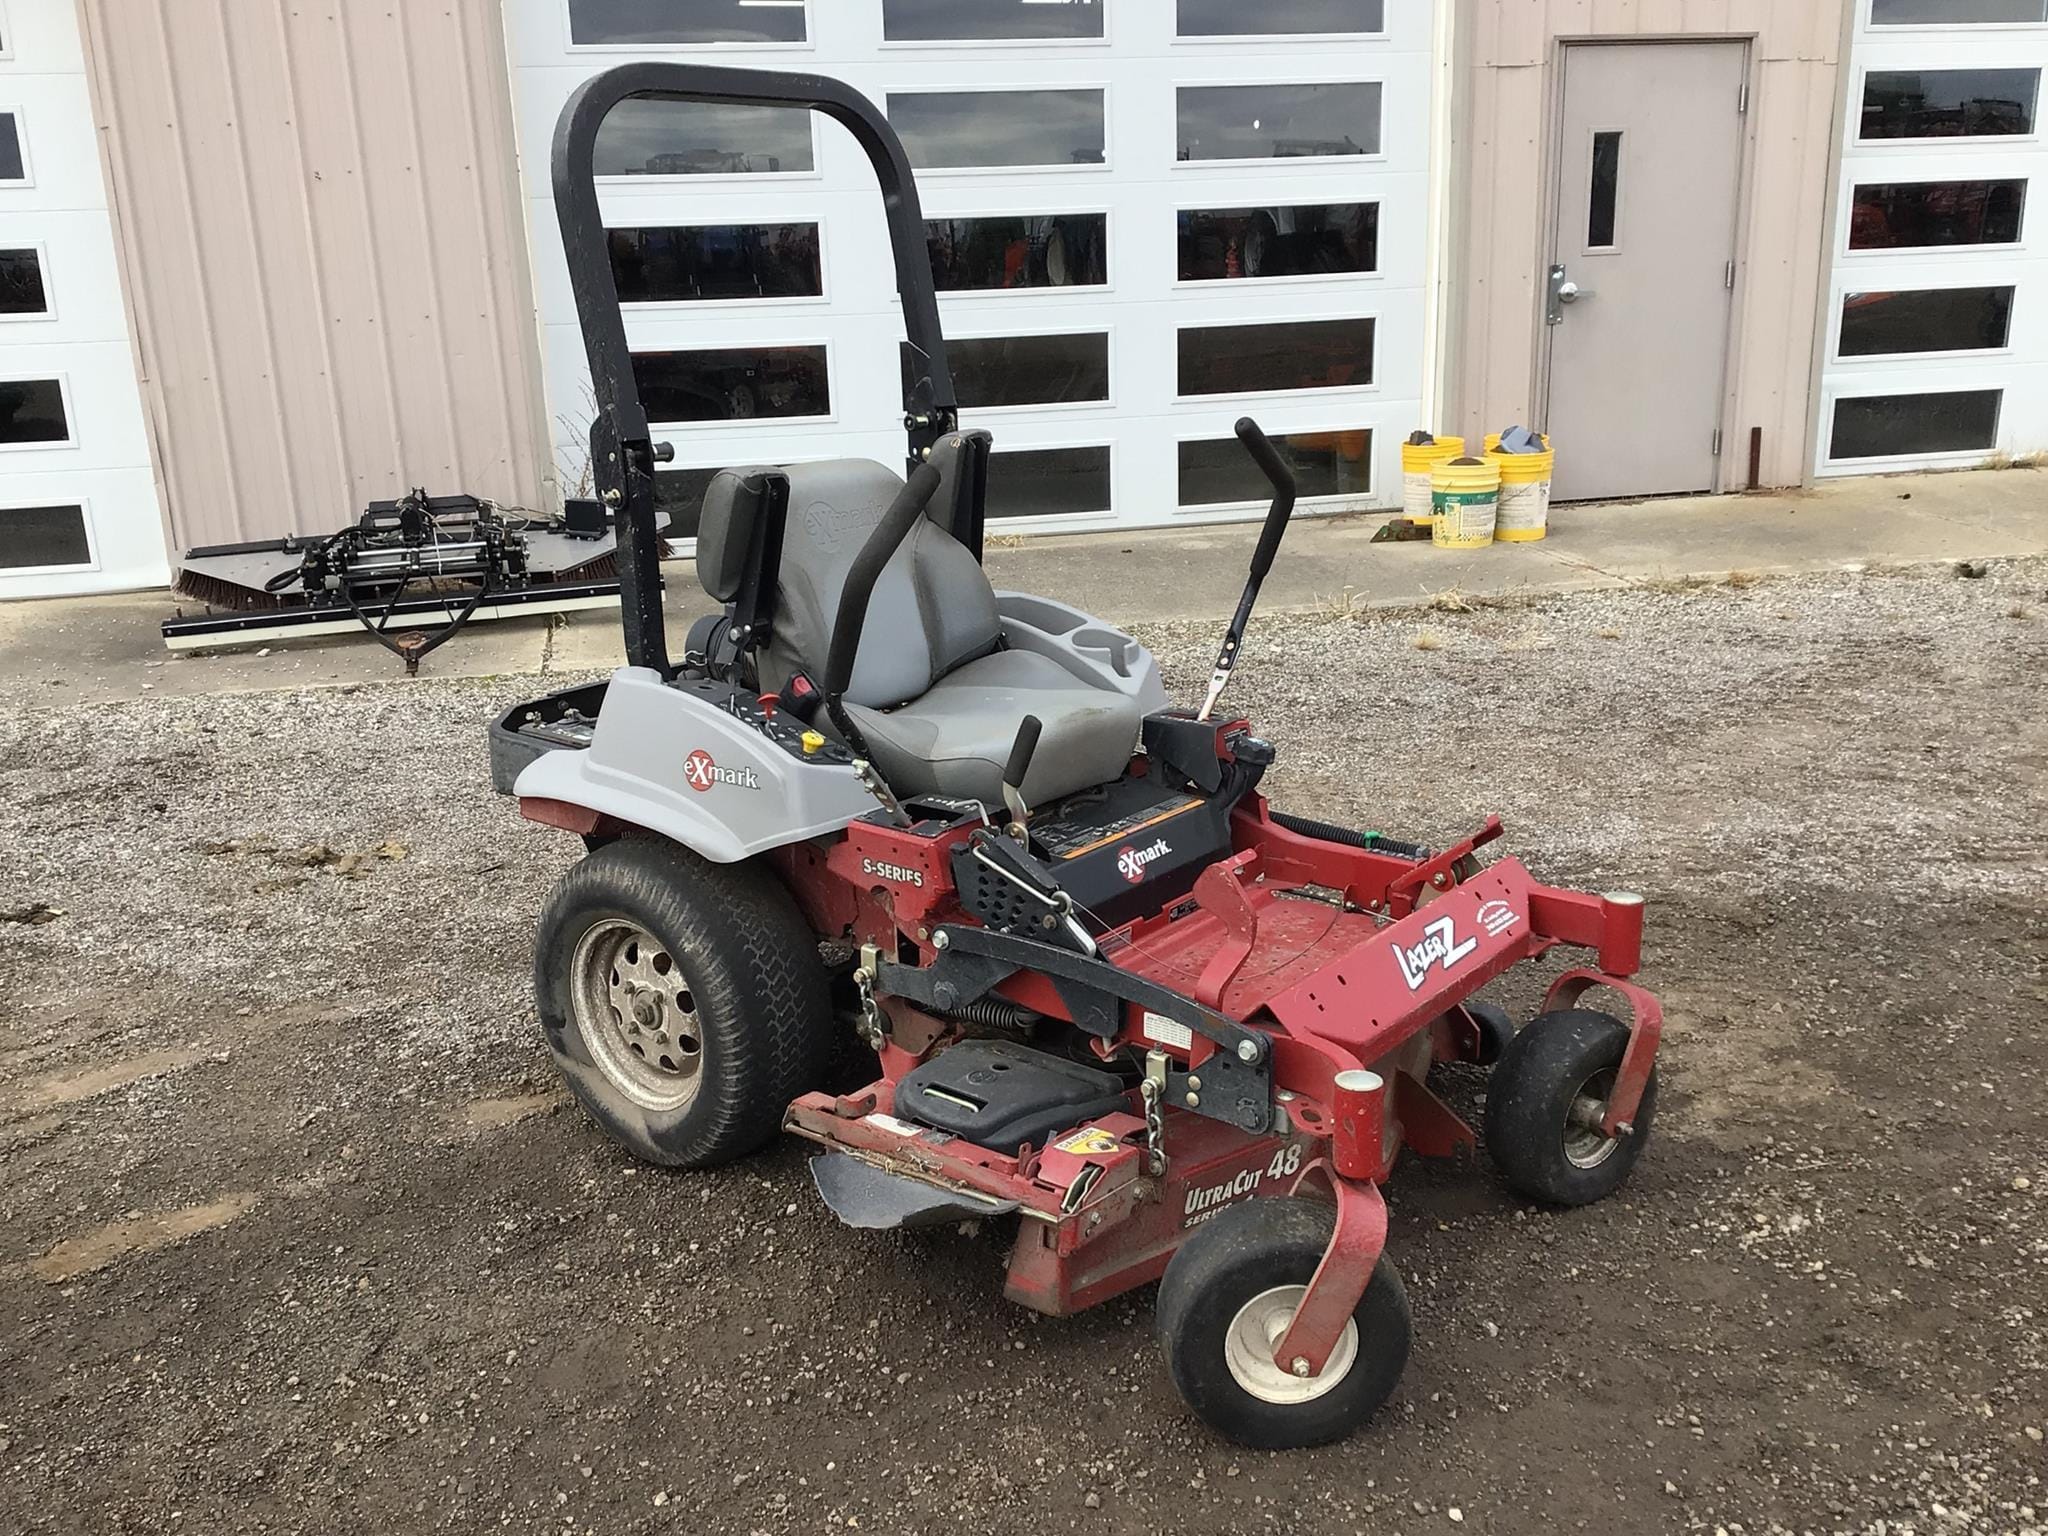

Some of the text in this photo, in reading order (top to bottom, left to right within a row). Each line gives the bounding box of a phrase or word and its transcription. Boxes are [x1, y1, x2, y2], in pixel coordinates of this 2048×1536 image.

[683, 755, 758, 789] eXmark
[1118, 838, 1170, 879] eXmark
[1424, 915, 1478, 970] Z
[1266, 1143, 1302, 1180] 48
